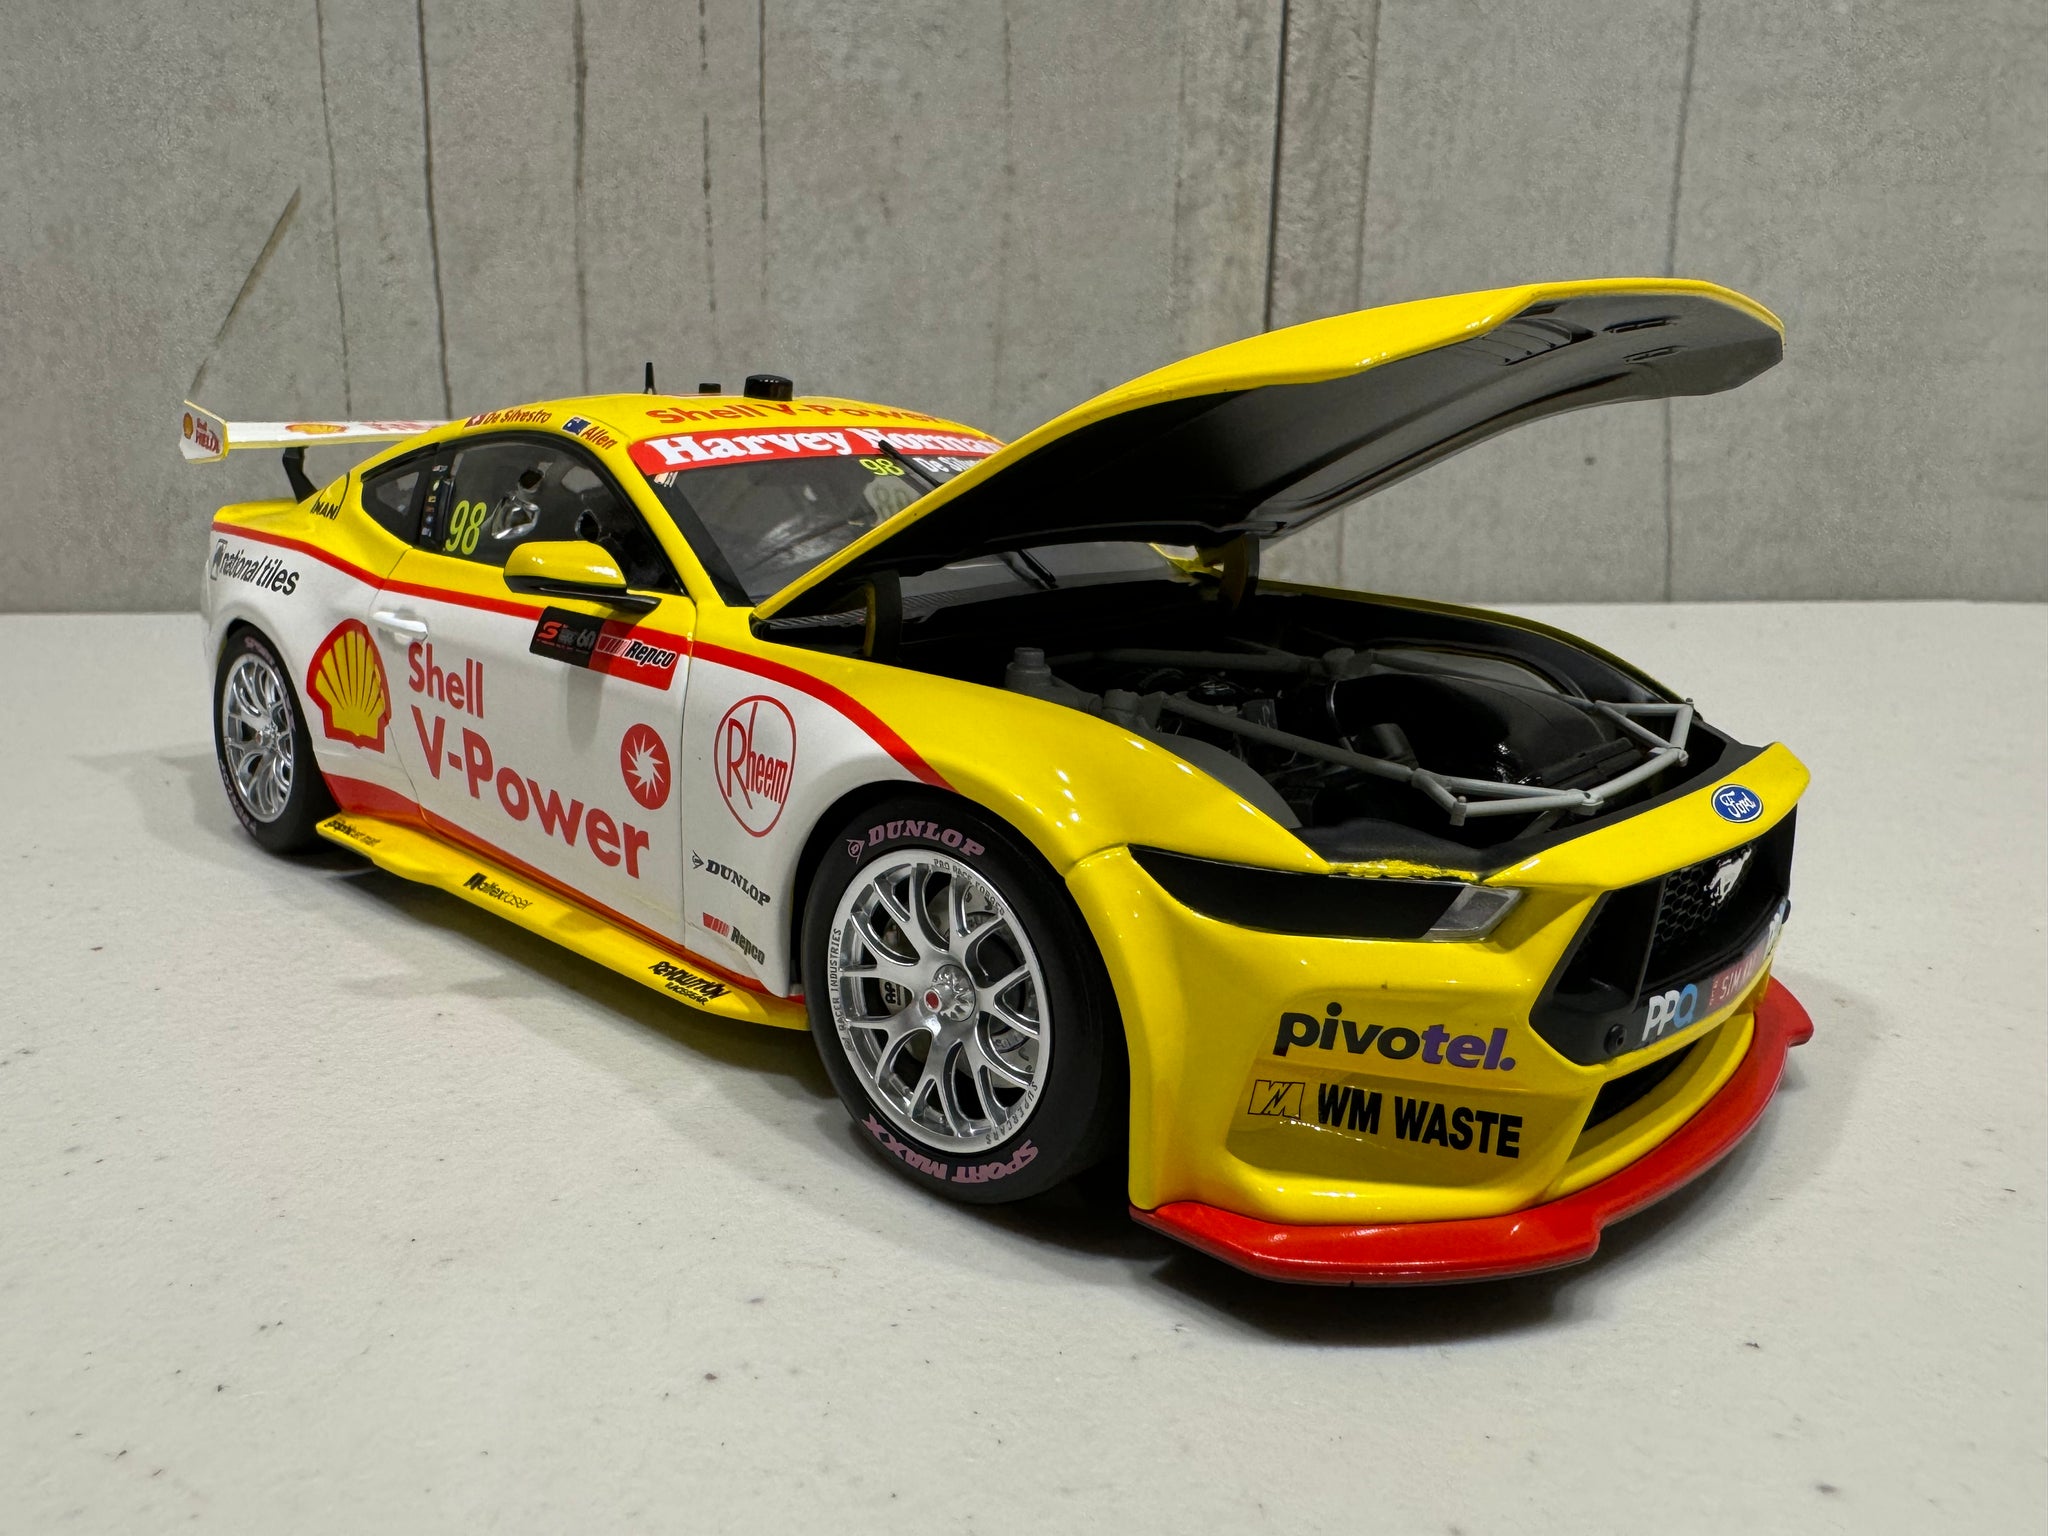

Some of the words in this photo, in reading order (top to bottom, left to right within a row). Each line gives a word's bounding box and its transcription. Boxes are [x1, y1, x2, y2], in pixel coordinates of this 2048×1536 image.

[483, 411, 500, 425] De
[501, 408, 552, 424] Silvestro
[645, 403, 761, 424] Shell
[580, 426, 618, 450] Allen
[645, 431, 855, 465] Harvey
[859, 457, 905, 477] 98
[912, 456, 949, 472] De
[445, 500, 487, 555] 98
[256, 558, 300, 596] tiles
[624, 641, 677, 667] Repco
[408, 641, 484, 719] Shell
[726, 701, 788, 810] Rheem
[410, 704, 650, 880] V-Power
[1719, 790, 1757, 818] Ford
[867, 819, 985, 857] DUNLOP
[705, 859, 771, 907] DUNLOP
[730, 926, 765, 966] Repco
[829, 928, 842, 992] INDUSTRIES
[1641, 983, 1698, 1042] PPQ
[1272, 1001, 1516, 1071] pivotel.
[985, 1081, 1038, 1145] SUPERCARS
[1317, 1082, 1383, 1136] WM
[1394, 1095, 1523, 1159] WASTE
[860, 1113, 948, 1180] MAXX
[951, 1139, 1039, 1184] SPORT
